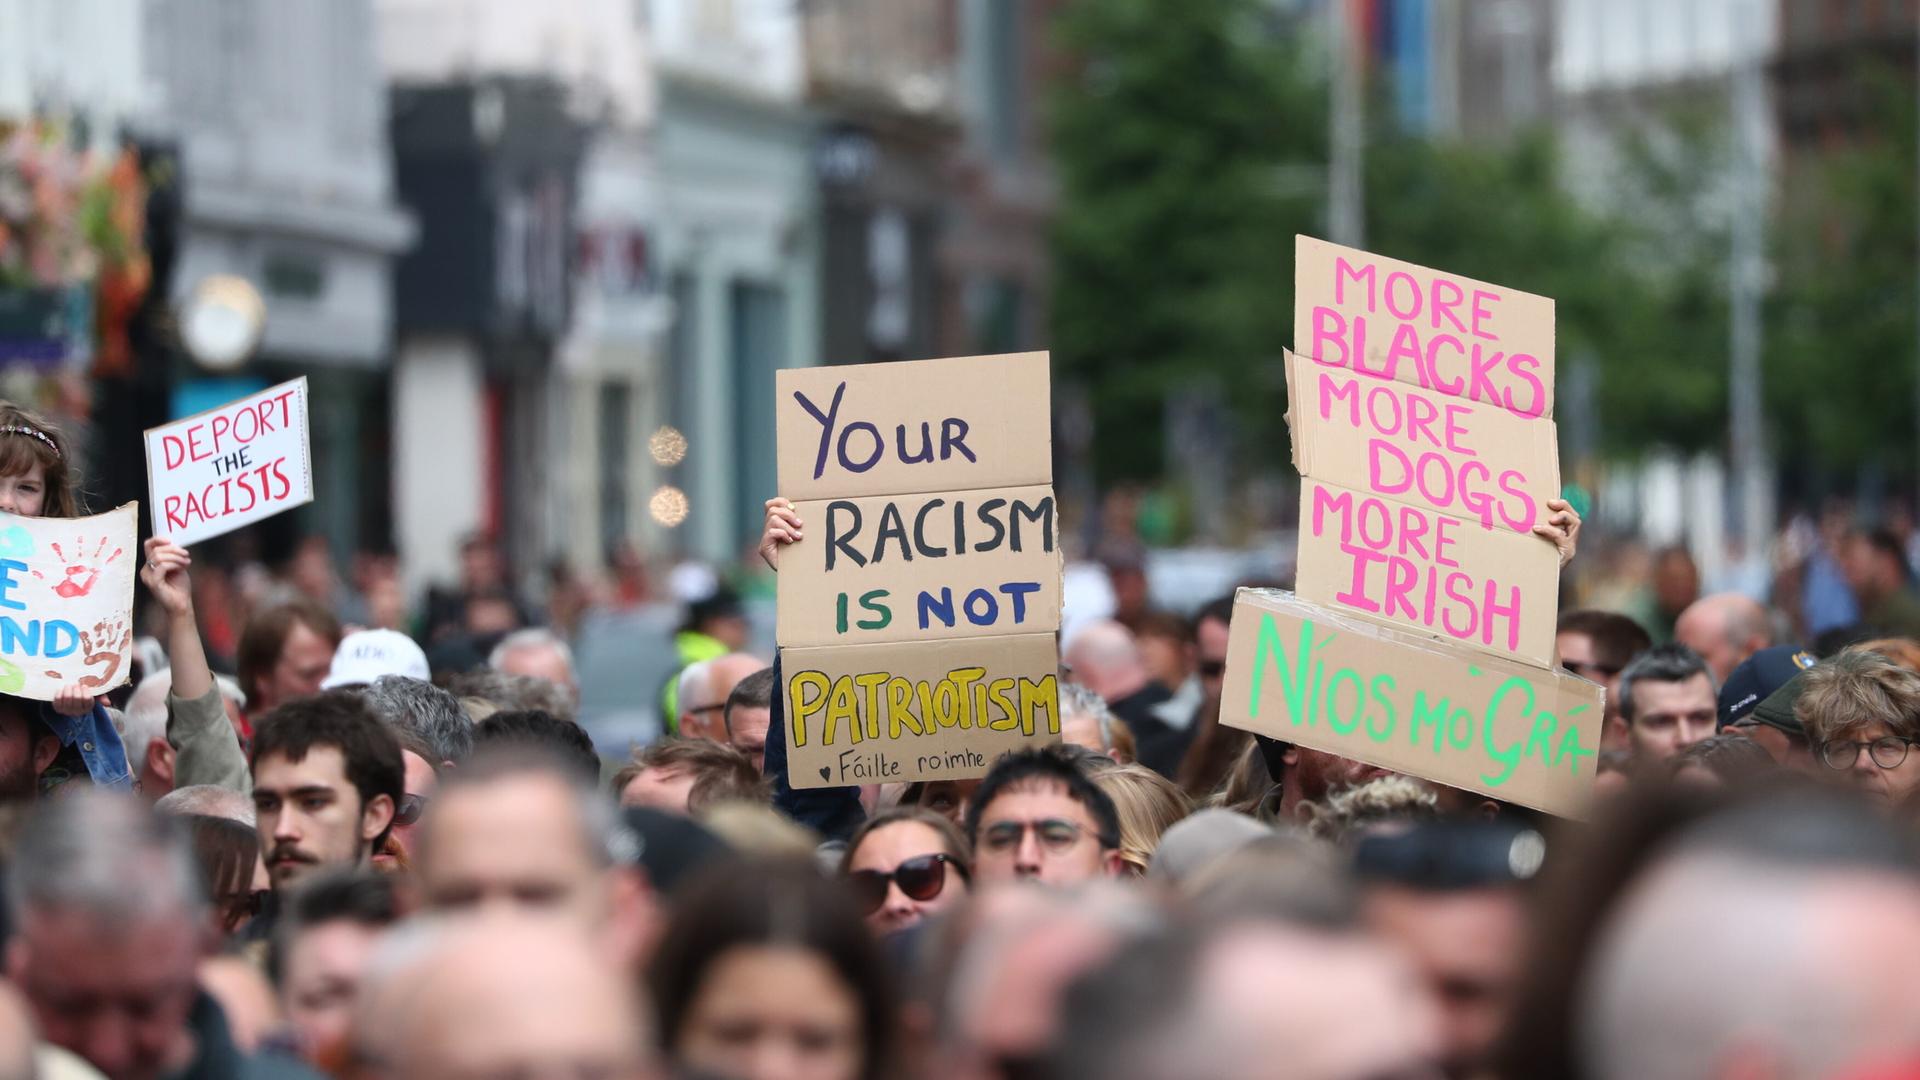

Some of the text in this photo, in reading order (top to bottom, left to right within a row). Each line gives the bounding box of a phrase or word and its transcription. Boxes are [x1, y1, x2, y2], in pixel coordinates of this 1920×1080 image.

[1335, 256, 1500, 341] MORE
[1312, 306, 1545, 420] BLACKS
[163, 390, 295, 470] DEPORT
[794, 381, 977, 480] YOUR
[1318, 373, 1476, 456] MORE
[164, 457, 291, 532] RACISTS
[212, 446, 252, 476] THE
[1368, 438, 1537, 533] DOGS
[825, 496, 1054, 572] RACISM
[1312, 485, 1461, 568] MORE
[836, 582, 1041, 633] IS NOT
[1338, 542, 1521, 651] IRISH
[789, 667, 1061, 748] PATRIOTISM
[838, 749, 901, 783] Fáilte
[917, 747, 986, 773] roimhe
